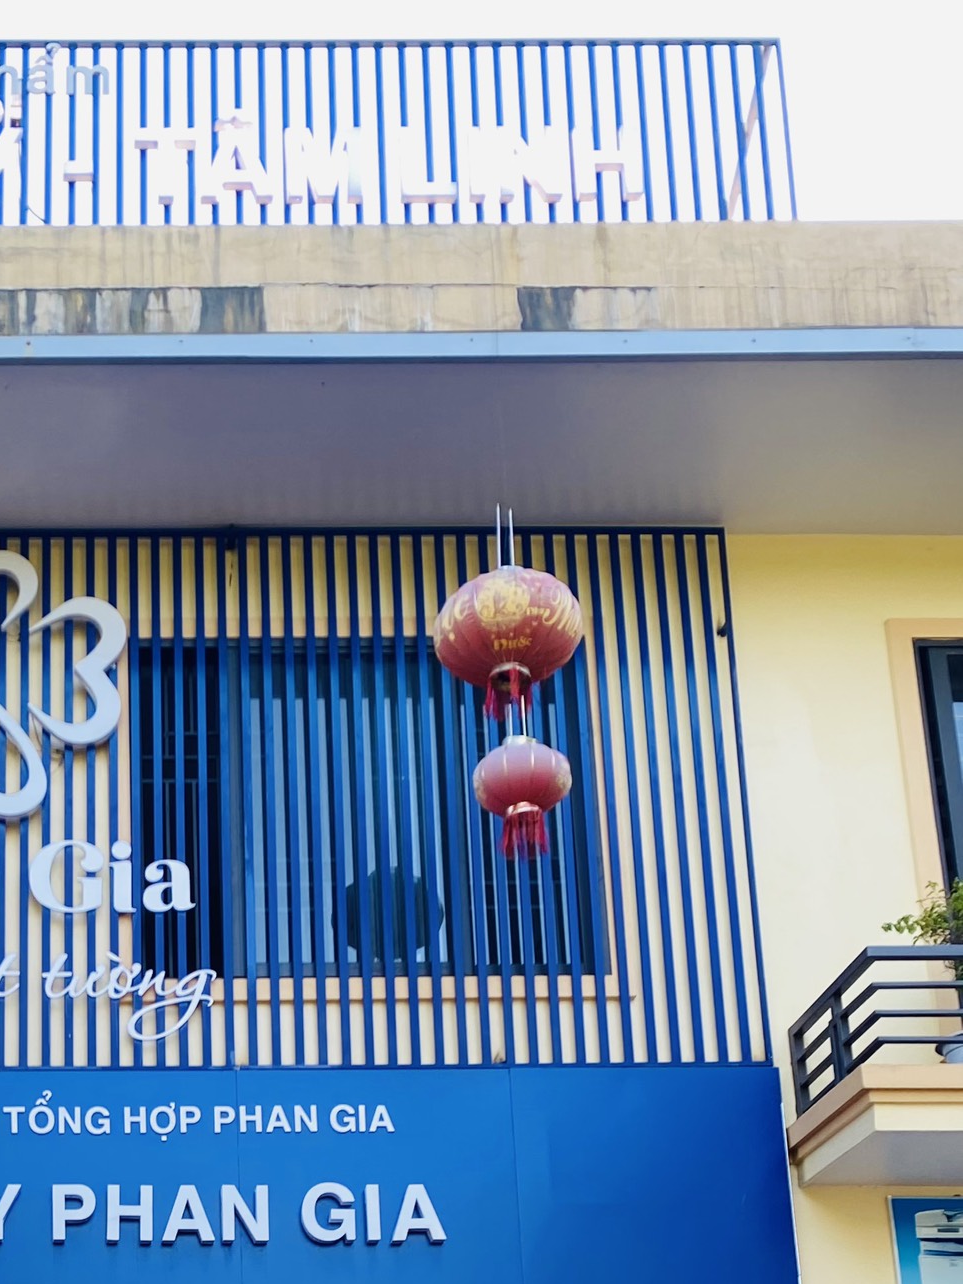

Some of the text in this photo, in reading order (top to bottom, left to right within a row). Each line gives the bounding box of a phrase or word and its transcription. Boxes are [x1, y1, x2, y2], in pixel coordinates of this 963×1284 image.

[134, 110, 363, 205] TÂM
[400, 125, 645, 204] LINH
[29, 839, 196, 915] Gia
[40, 951, 218, 1042] tường
[3, 1090, 112, 1135] TỔNG
[123, 1101, 202, 1142] HỢP
[214, 1104, 319, 1134] PHAN
[330, 1103, 396, 1134] GIA
[52, 1183, 270, 1246] PHAN
[300, 1182, 448, 1246] GIA
